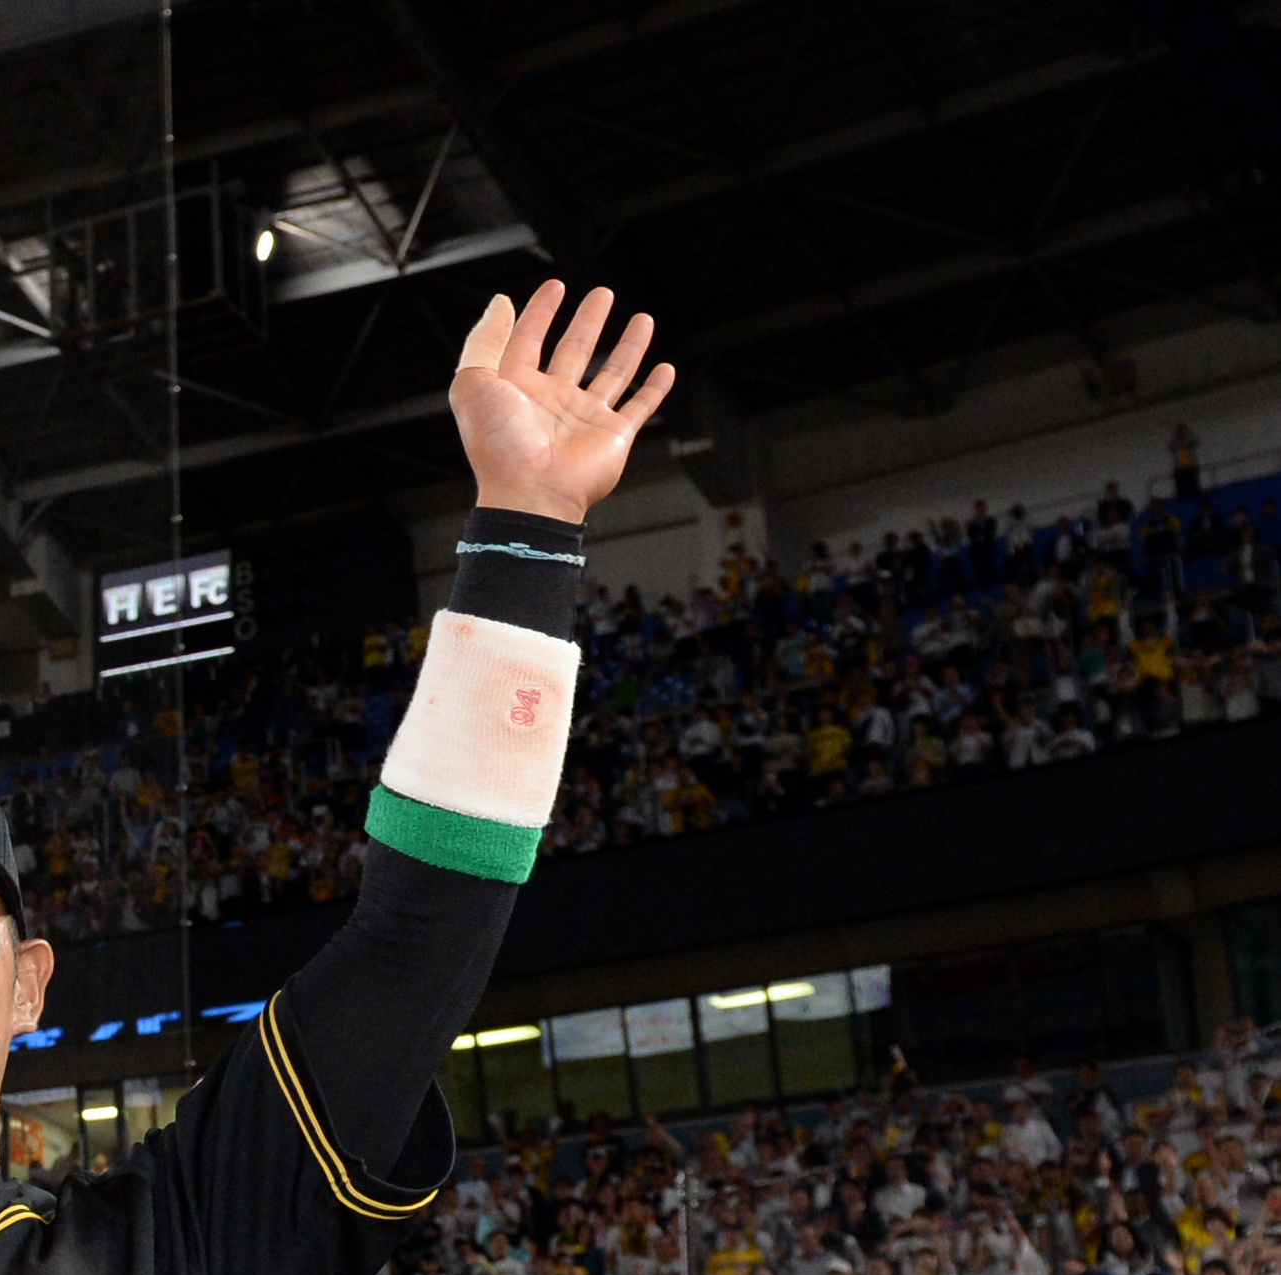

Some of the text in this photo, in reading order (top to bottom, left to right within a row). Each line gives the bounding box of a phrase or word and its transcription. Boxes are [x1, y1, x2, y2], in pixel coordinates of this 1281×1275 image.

[104, 583, 141, 625] H
[148, 577, 182, 616] E
[510, 688, 541, 726] 94
